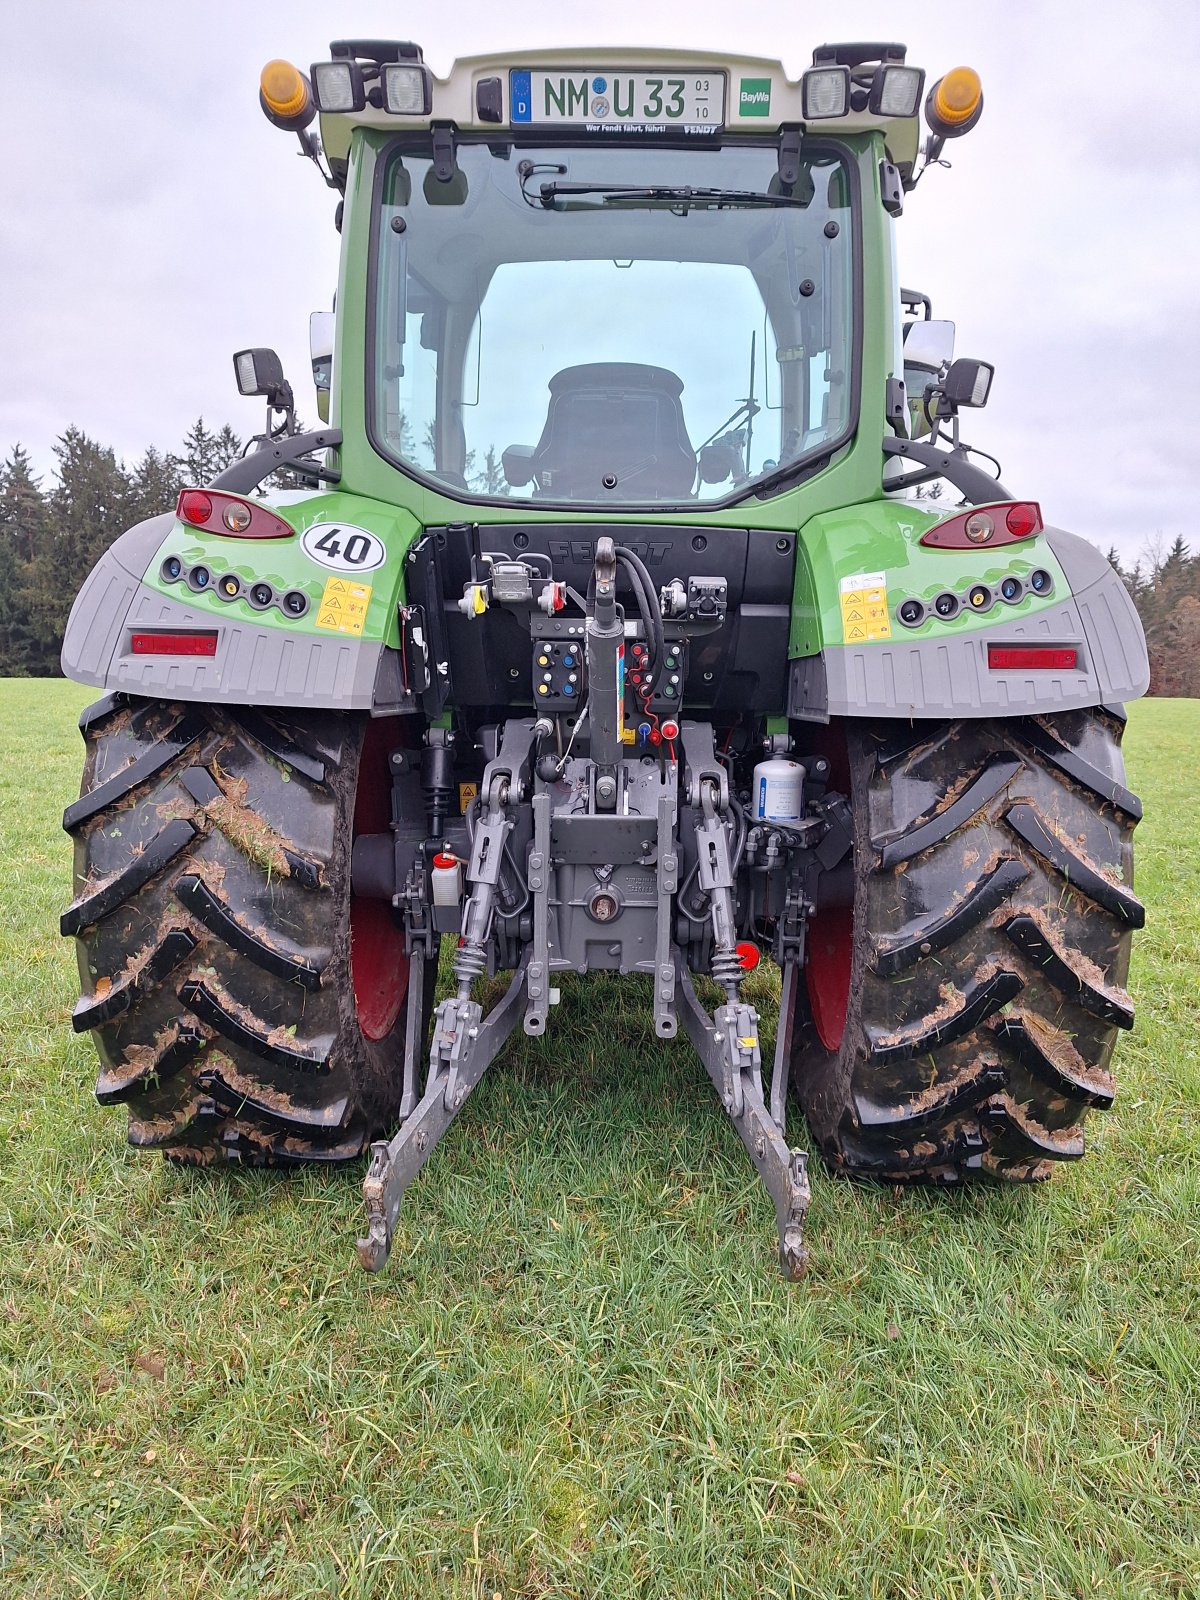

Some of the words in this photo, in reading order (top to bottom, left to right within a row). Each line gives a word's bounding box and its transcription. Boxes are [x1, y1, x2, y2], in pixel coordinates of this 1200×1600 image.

[695, 79, 709, 91] 03
[544, 77, 589, 117] NM
[613, 78, 635, 118] U
[643, 78, 686, 118] 33
[740, 91, 770, 103] BayWa
[518, 102, 526, 114] D
[695, 107, 709, 119] 10
[585, 124, 600, 132] Wer
[602, 124, 622, 132] Fendt
[623, 124, 644, 133] fährt,
[645, 125, 666, 133] führt!
[684, 125, 718, 134] FENDT
[313, 528, 372, 565] 40
[547, 540, 674, 565] FEDT
